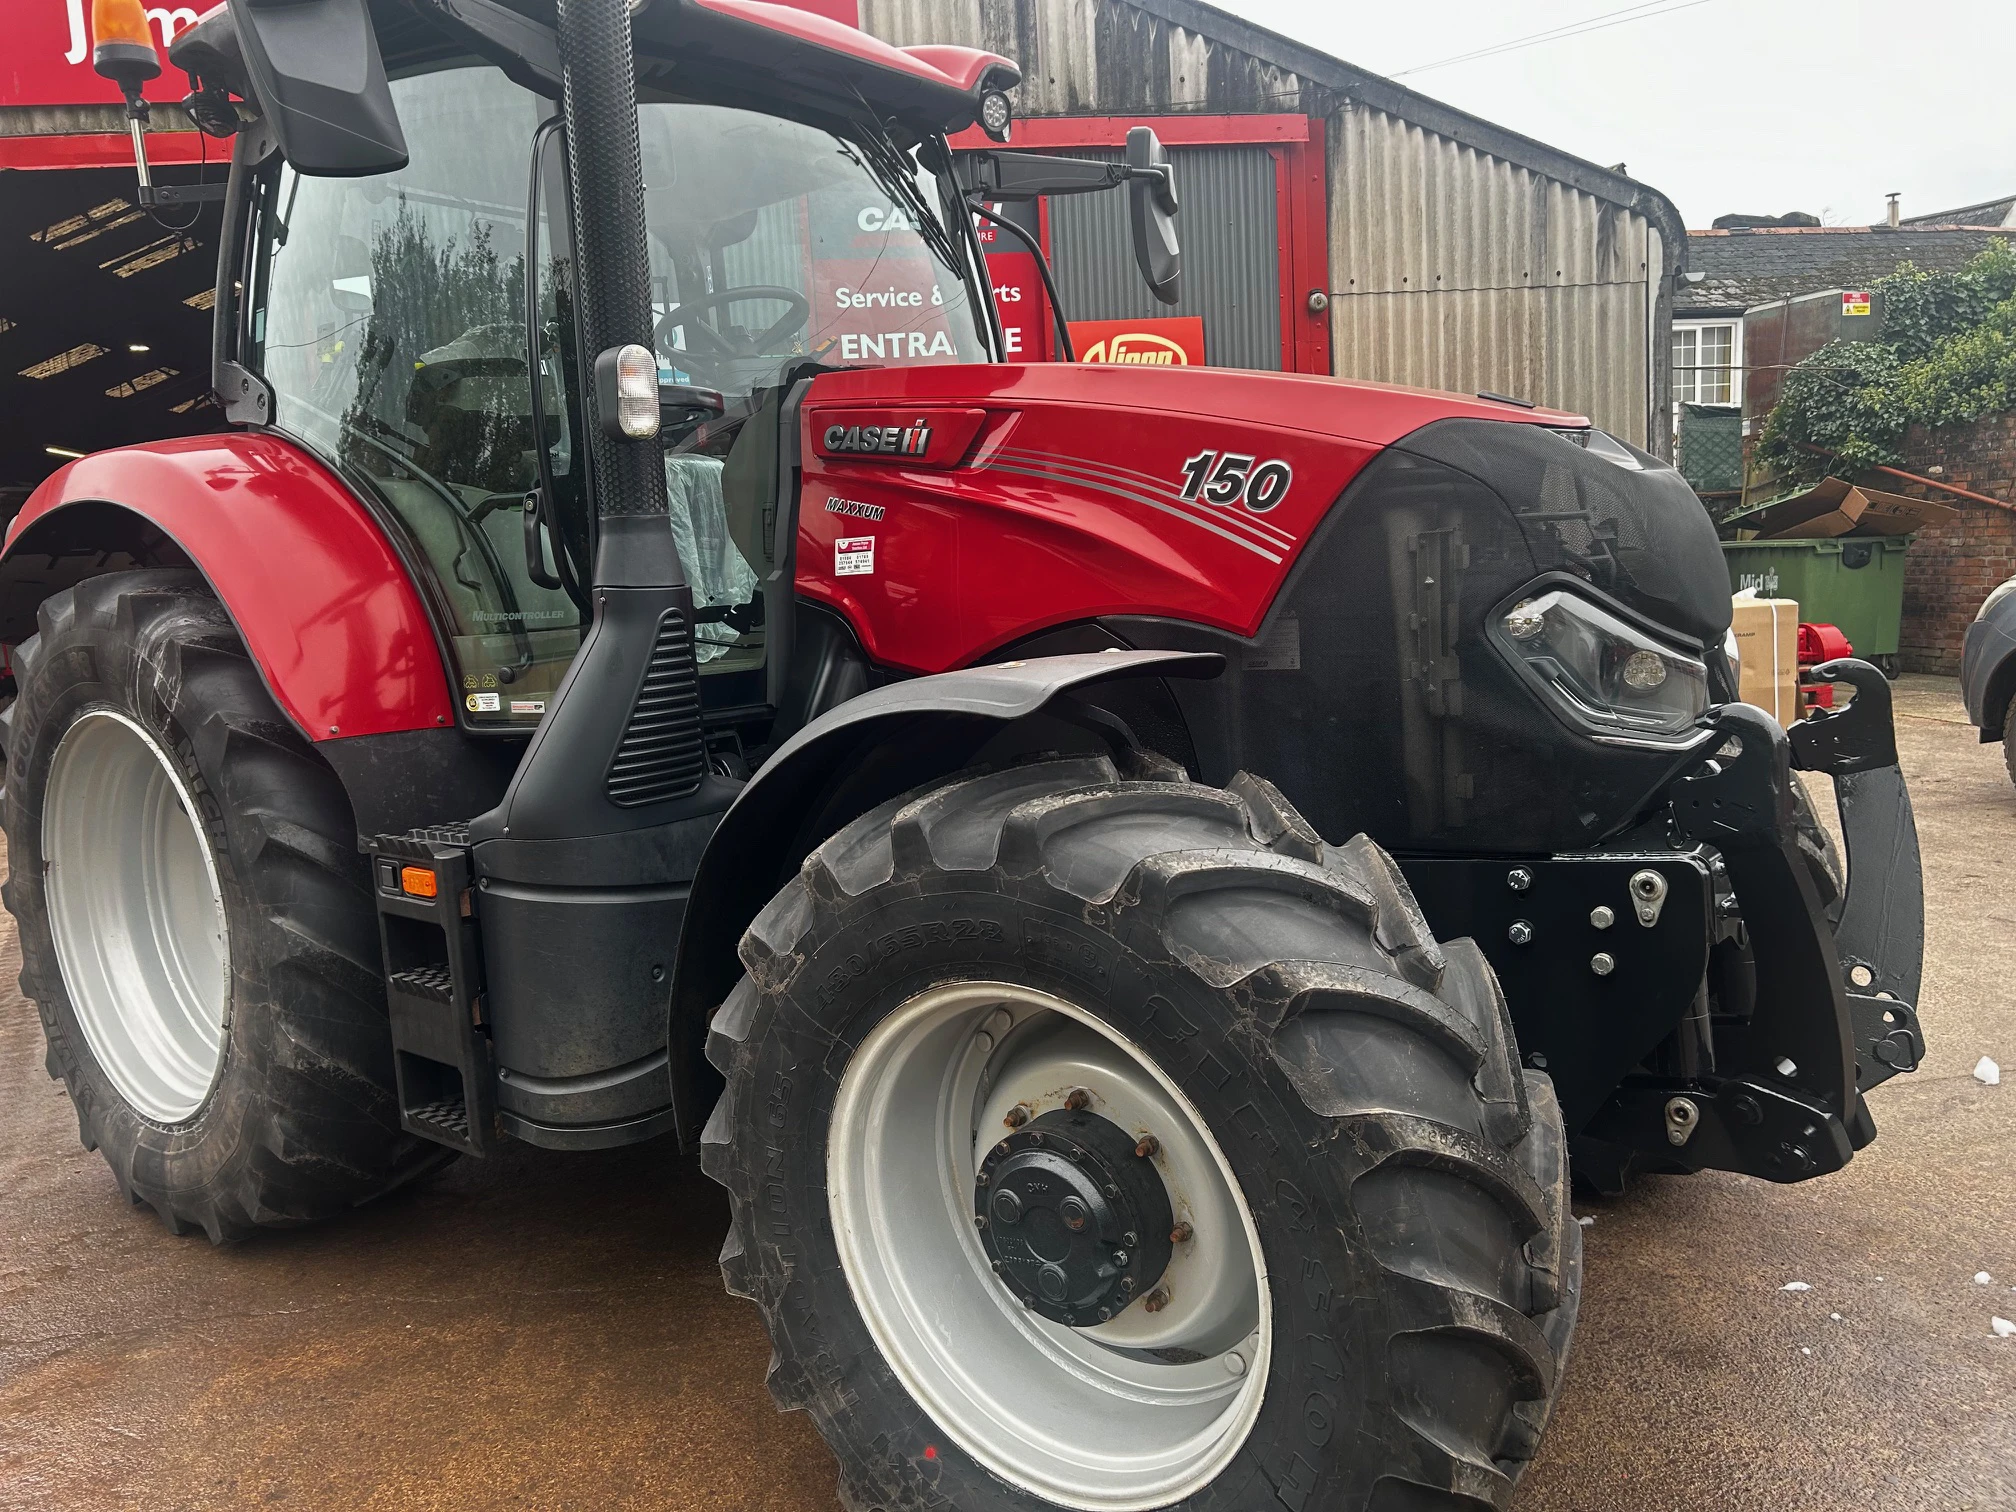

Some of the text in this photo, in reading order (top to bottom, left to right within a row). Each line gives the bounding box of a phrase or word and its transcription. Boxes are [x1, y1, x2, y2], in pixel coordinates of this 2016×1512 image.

[835, 286, 923, 308] Service
[993, 286, 1021, 302] rts
[824, 424, 902, 454] CASE
[1179, 450, 1293, 513] 150
[825, 497, 886, 521] MAXXUM
[1740, 573, 1764, 591] Mid
[472, 610, 566, 622] MULTICONTROLLER
